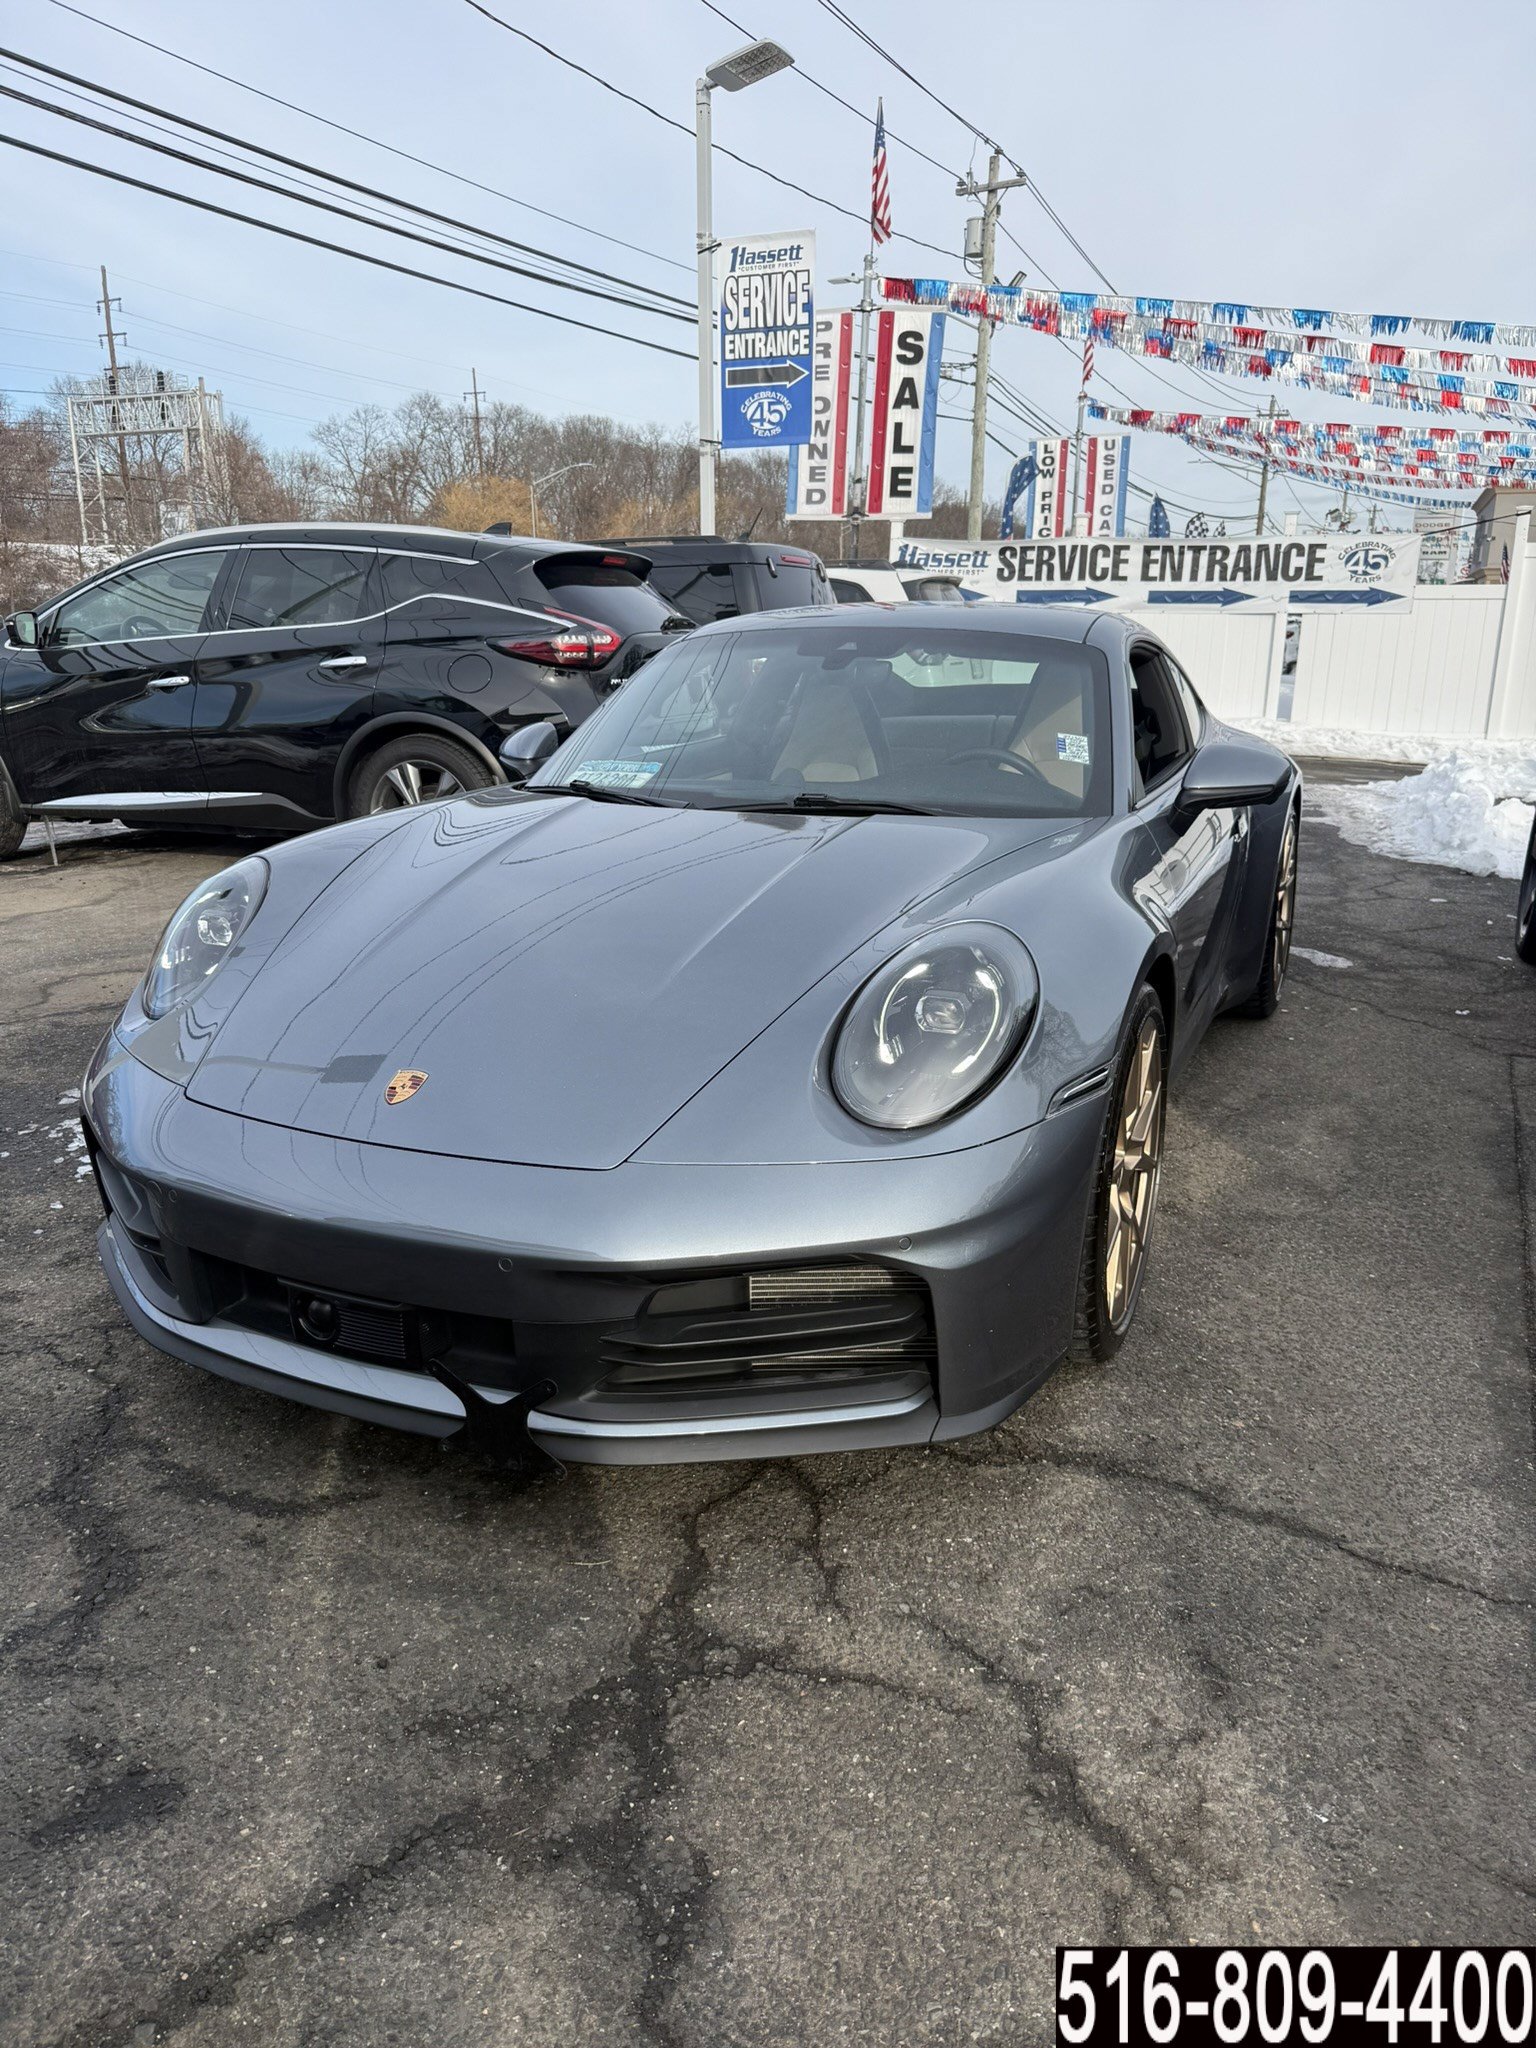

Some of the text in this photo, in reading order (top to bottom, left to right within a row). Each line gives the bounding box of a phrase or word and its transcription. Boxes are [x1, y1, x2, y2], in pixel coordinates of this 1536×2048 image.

[723, 269, 811, 331] SERVICE
[724, 328, 811, 360] ENTRANCE
[740, 391, 792, 413] CELEBRATING
[747, 400, 786, 428] 45
[805, 321, 833, 505] PRE OWNED
[889, 330, 925, 499] SALE
[752, 427, 782, 437] YEARS
[1038, 444, 1056, 538] LOW PRIC
[1099, 439, 1116, 537] USED CA
[996, 544, 1131, 582] SERVICE
[1140, 543, 1327, 583] ENTRANCE
[1338, 541, 1396, 560] CELEBRATING
[1346, 549, 1388, 575] 45
[1350, 574, 1381, 583] YEARS
